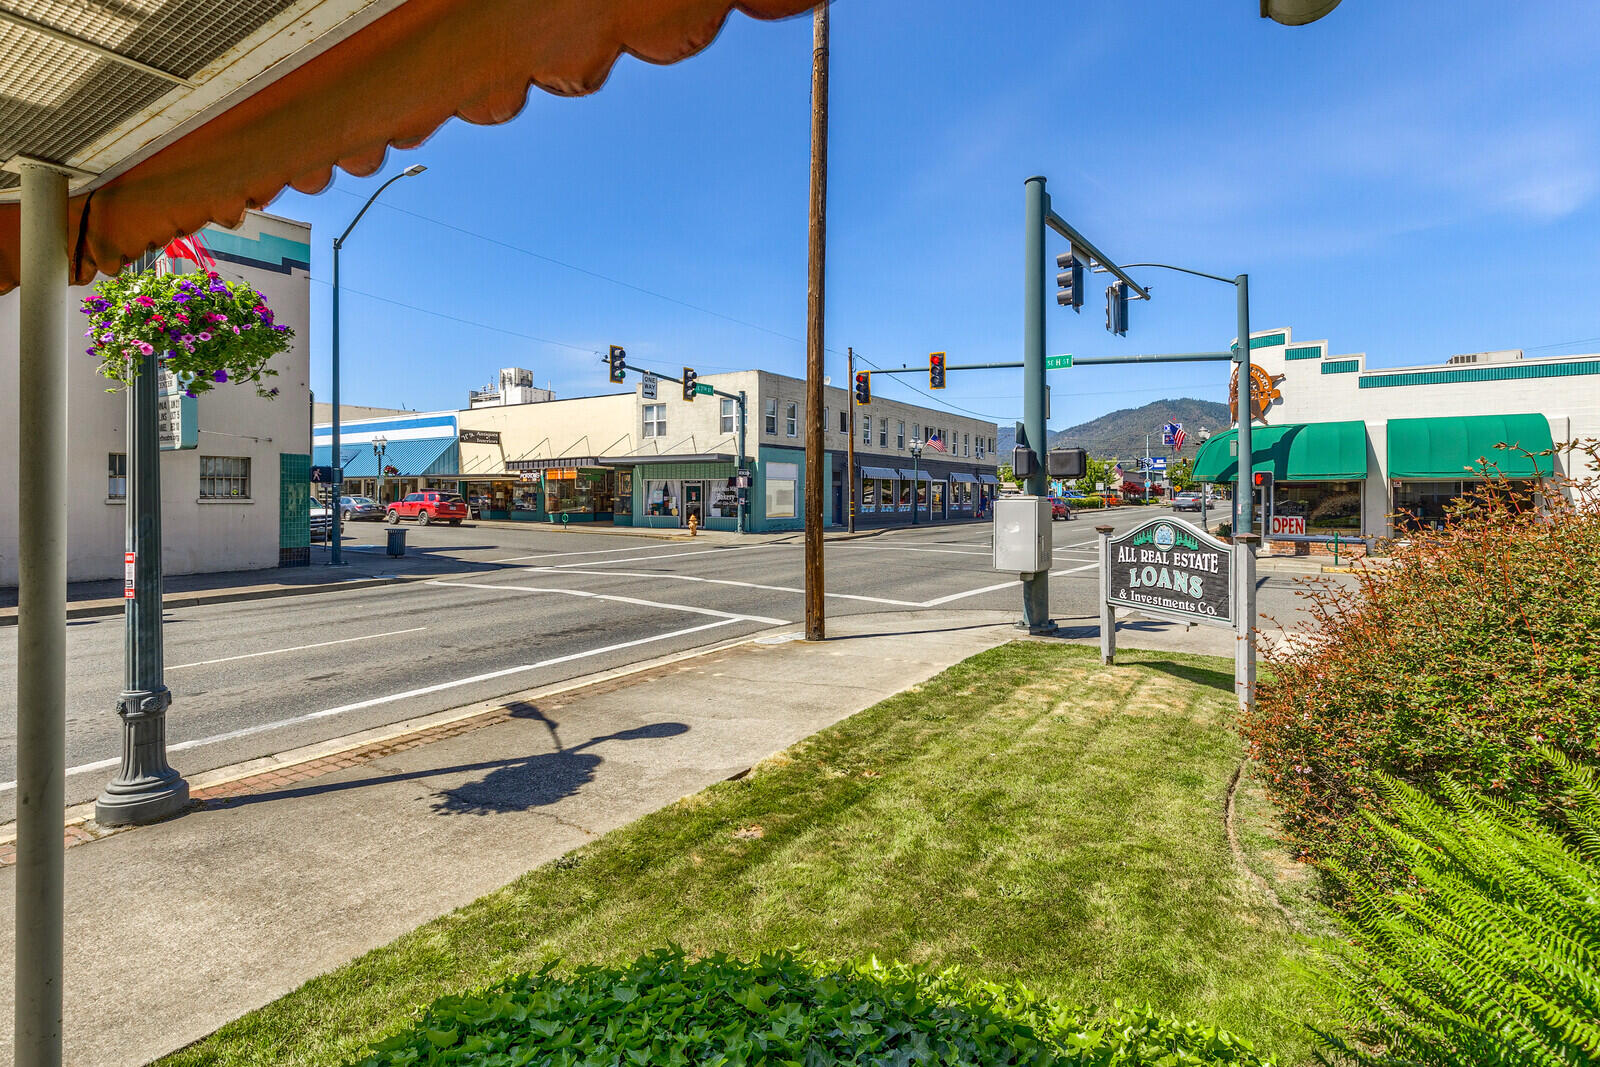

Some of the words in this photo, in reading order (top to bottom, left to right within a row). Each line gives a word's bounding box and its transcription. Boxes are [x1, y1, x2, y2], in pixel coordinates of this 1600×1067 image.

[1055, 358, 1061, 366] H
[644, 376, 656, 384] ONE
[1272, 517, 1305, 534] OPEN
[1118, 546, 1137, 563] ALL
[1140, 549, 1170, 565] REAL
[1173, 553, 1219, 574] ESTATE
[1129, 566, 1203, 599] LOANS
[1119, 588, 1127, 600] &
[1130, 590, 1196, 612] Investments
[1197, 602, 1218, 616] Co.
